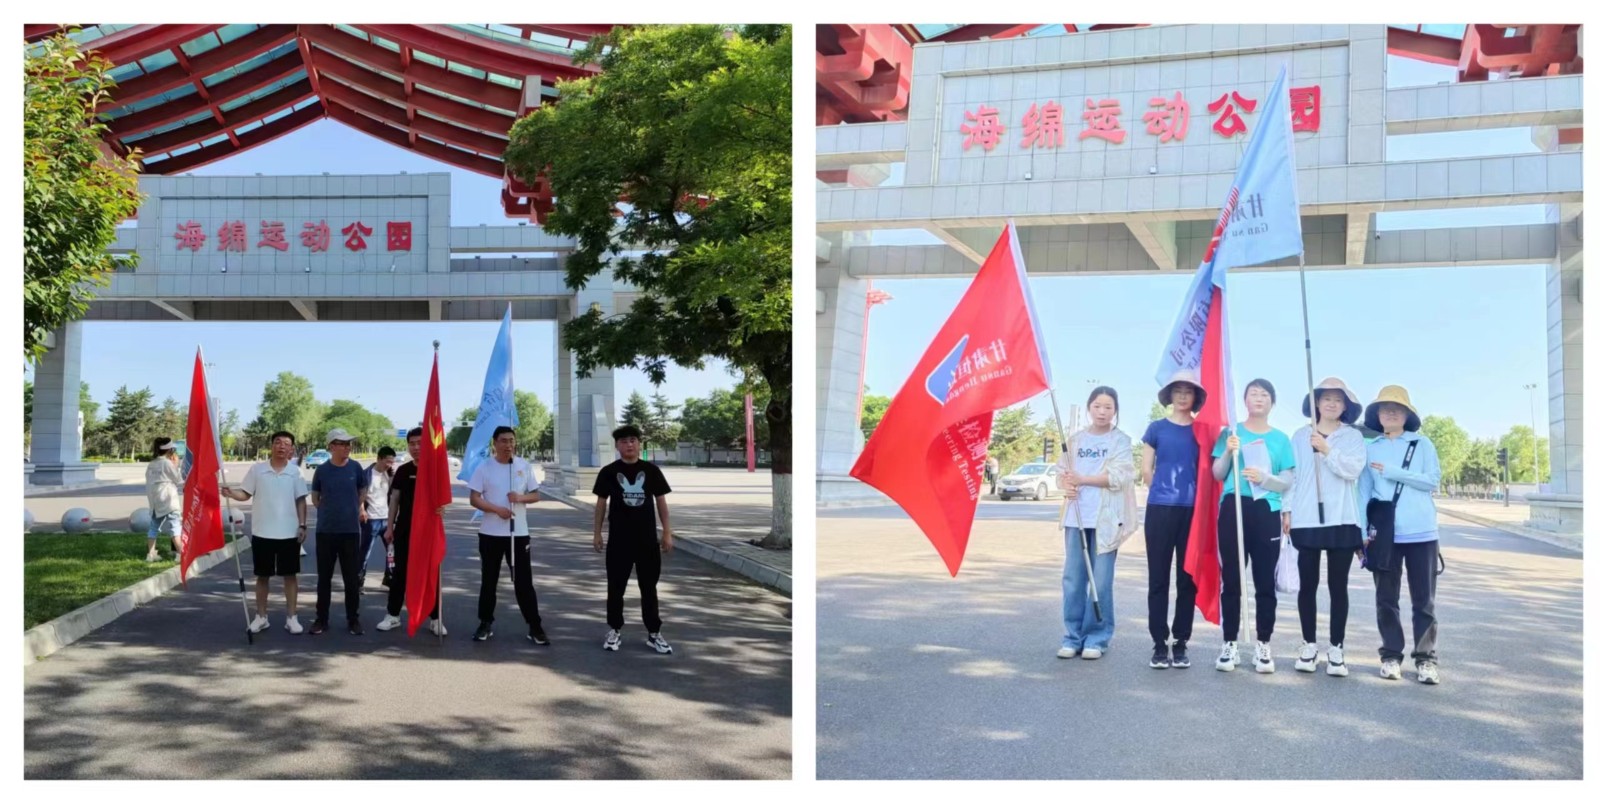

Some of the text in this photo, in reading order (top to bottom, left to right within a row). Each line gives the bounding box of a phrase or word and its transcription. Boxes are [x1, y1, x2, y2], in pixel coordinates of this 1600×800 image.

[960, 84, 1321, 152] 海绵运动公园
[174, 219, 412, 252] 海绵运动公园
[942, 428, 979, 501] eering Testing
